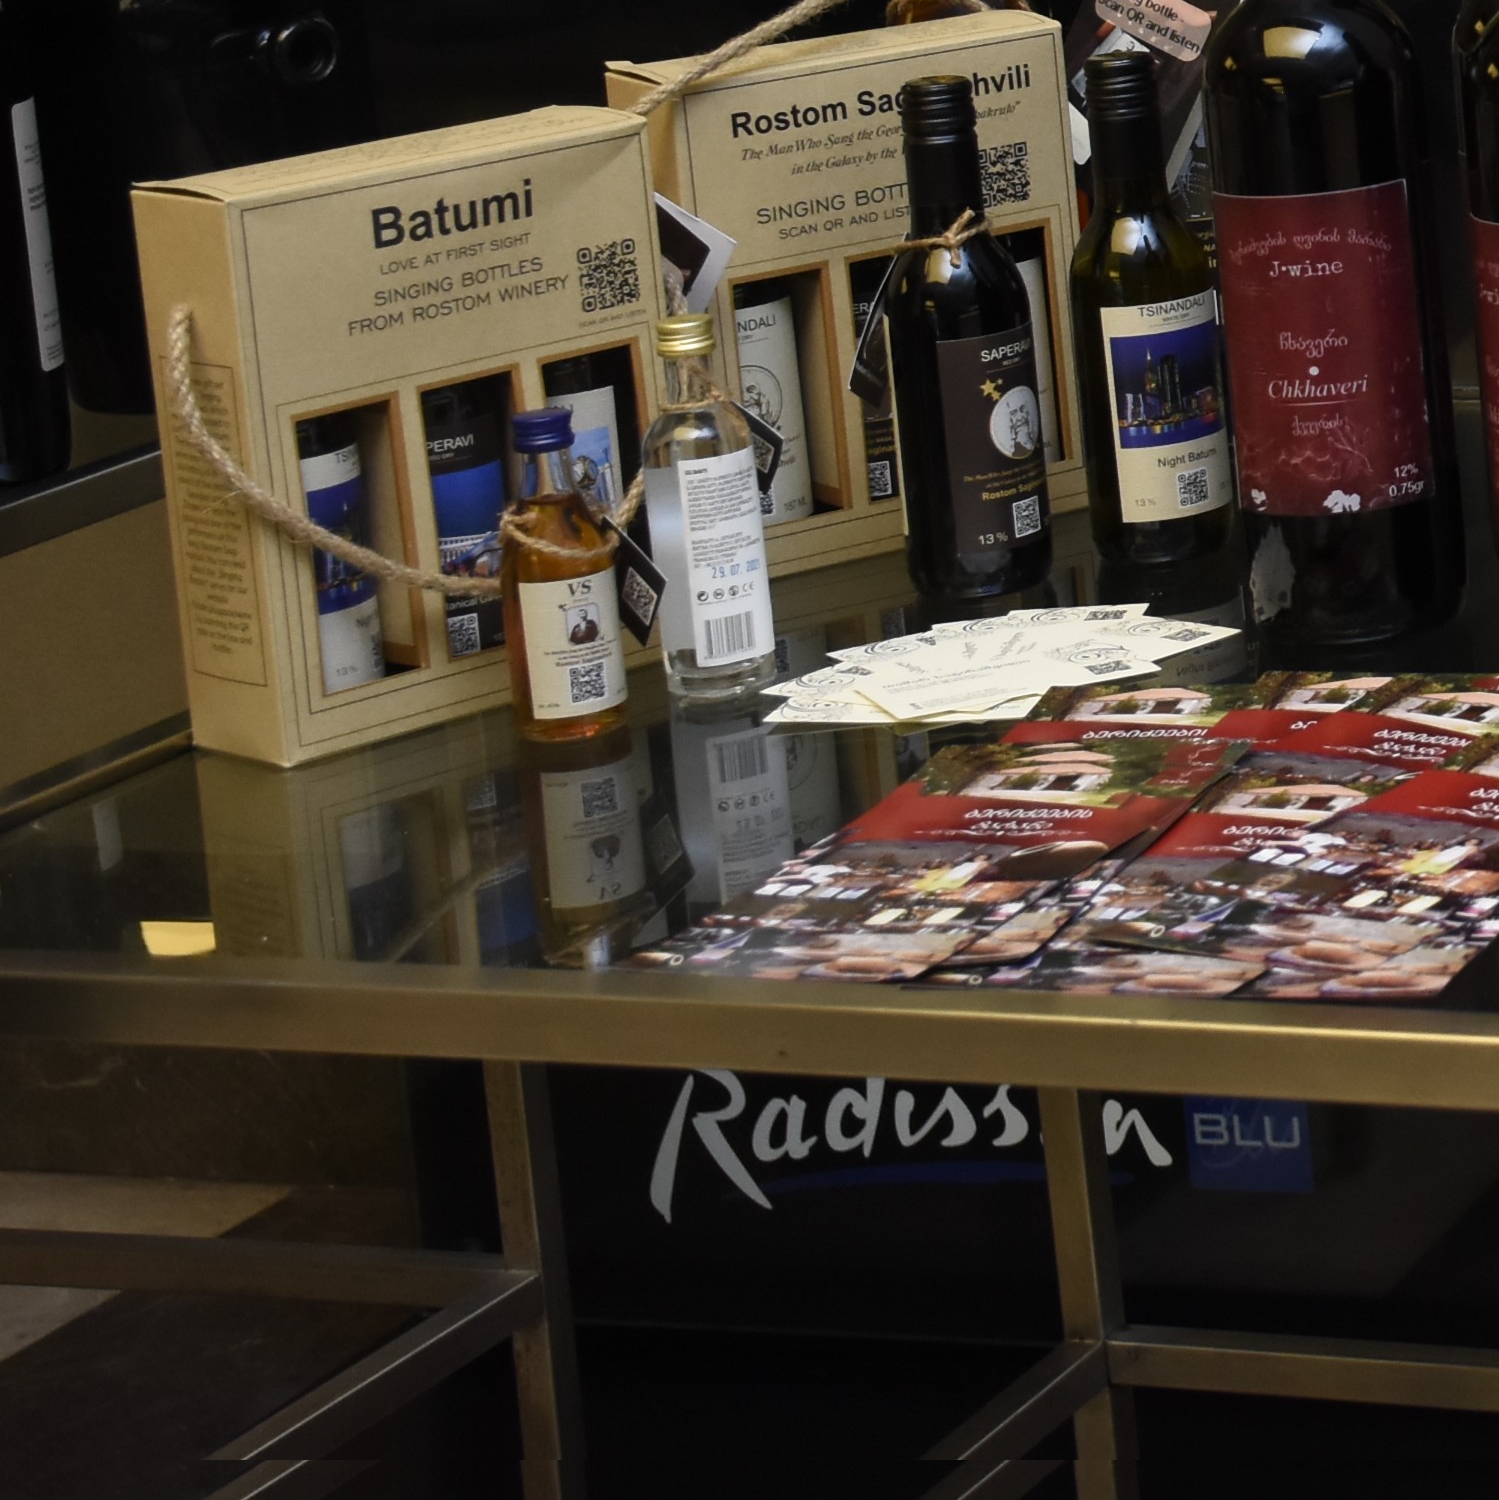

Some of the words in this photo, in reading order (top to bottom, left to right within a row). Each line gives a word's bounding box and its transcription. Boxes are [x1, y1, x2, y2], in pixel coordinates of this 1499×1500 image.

[1126, 8, 1145, 25] QR
[1145, 20, 1170, 37] and
[1170, 30, 1200, 54] listen
[731, 101, 848, 138] Rostom
[857, 129, 874, 141] the
[371, 178, 533, 249] Batumi
[756, 194, 846, 225] SINGING
[855, 183, 908, 206] BOTT
[778, 223, 818, 240] SCAN
[823, 218, 844, 233] QR
[849, 212, 879, 228] AND
[884, 205, 910, 221] LIST
[380, 257, 418, 275] LOVE
[424, 252, 443, 266] AT
[446, 243, 485, 261] FIRST
[490, 232, 532, 251] SIGHT
[374, 276, 453, 306] SINGING
[462, 257, 543, 288] BOTTLES
[348, 311, 404, 336] FROM
[413, 292, 492, 323] ROSTOM
[498, 274, 569, 302] WINERY
[1137, 294, 1206, 318] TSINANDALI
[1268, 374, 1368, 399] Chkhaveri
[1157, 451, 1186, 469] Night
[1394, 464, 1419, 479] 12%
[567, 580, 592, 596] VS
[649, 1067, 1173, 1224] Radissn
[1191, 1111, 1300, 1150] BLU
